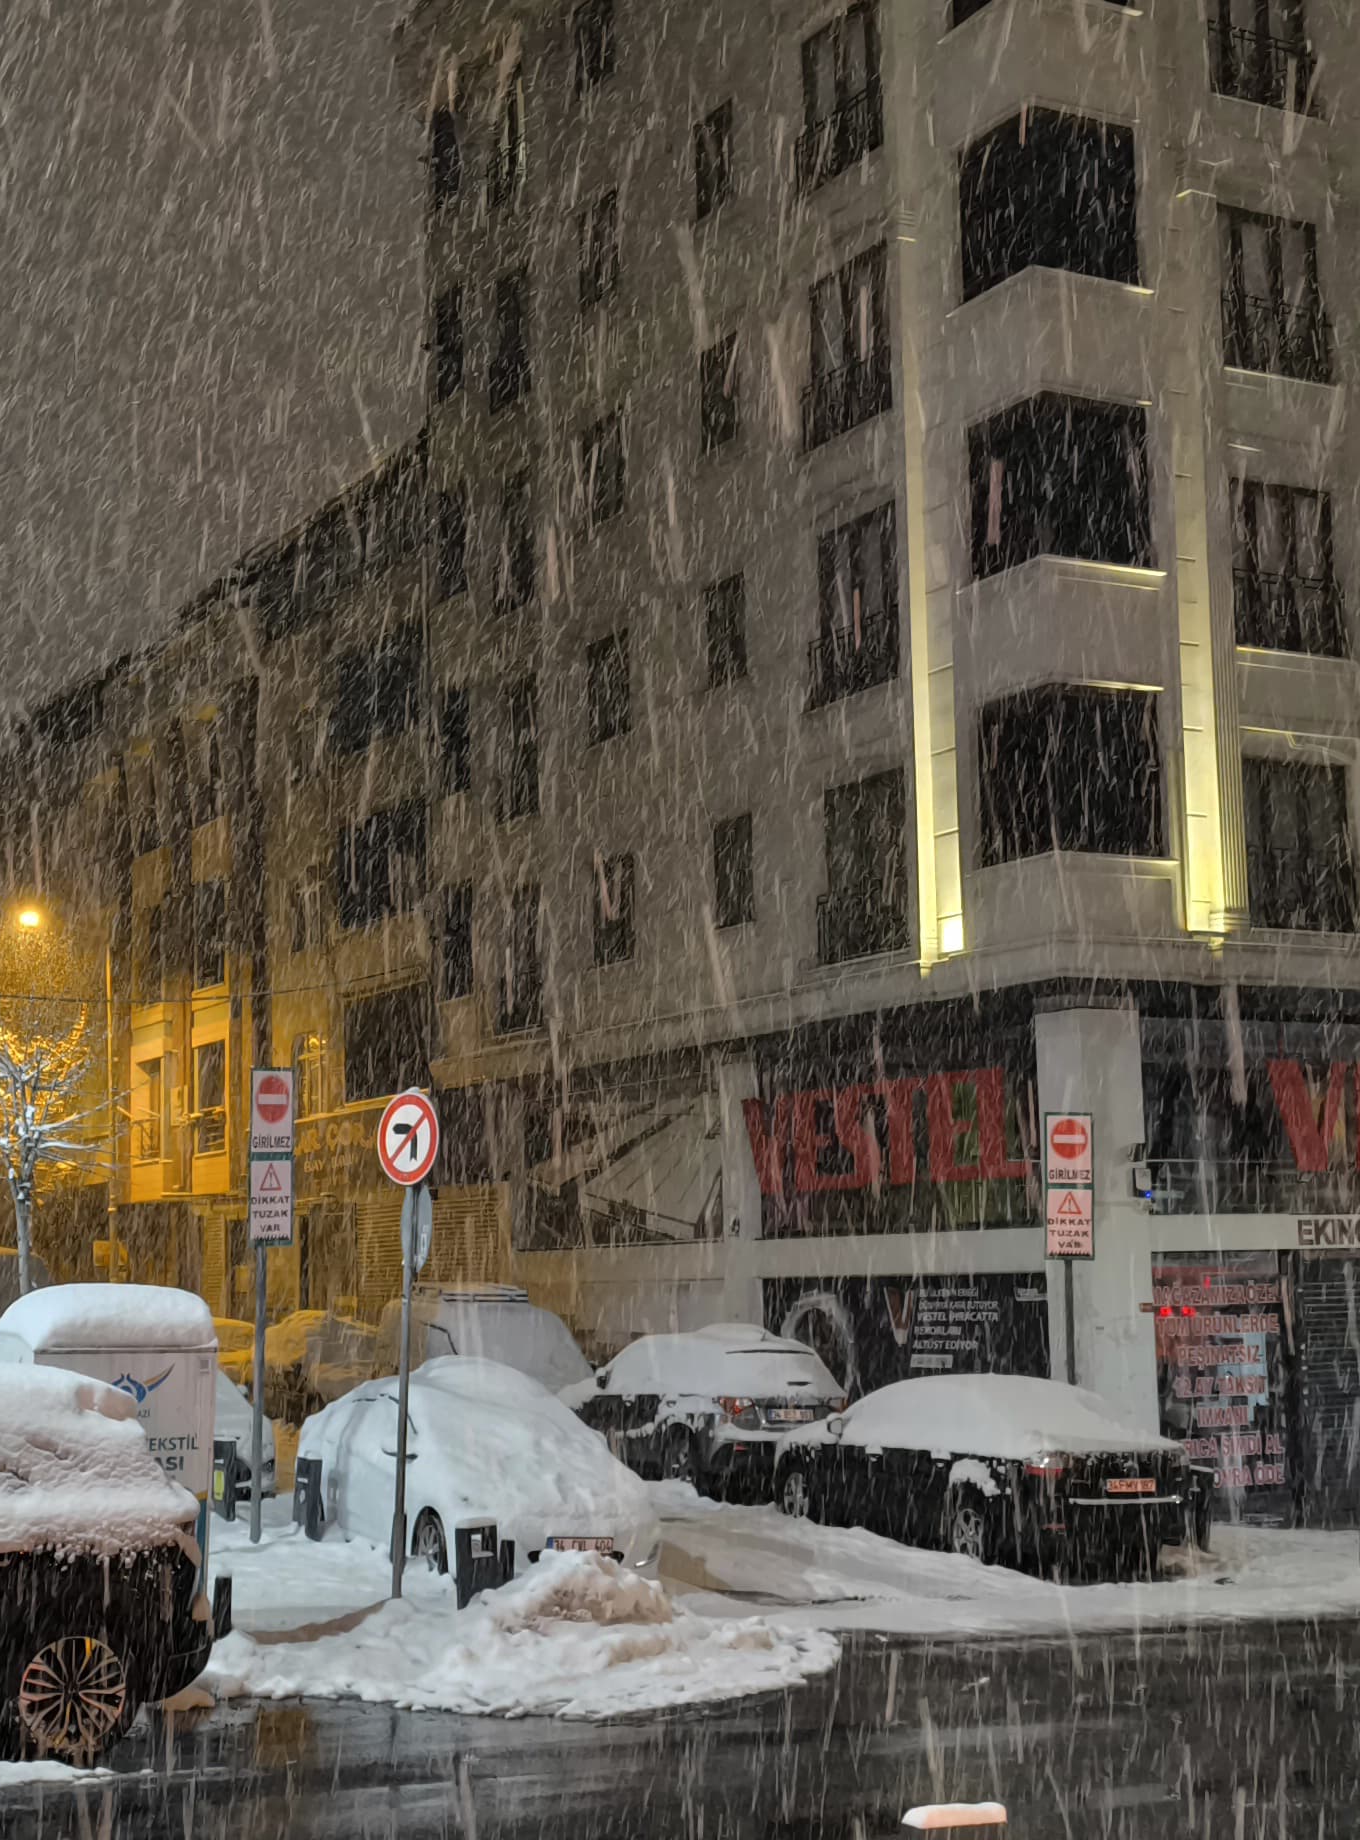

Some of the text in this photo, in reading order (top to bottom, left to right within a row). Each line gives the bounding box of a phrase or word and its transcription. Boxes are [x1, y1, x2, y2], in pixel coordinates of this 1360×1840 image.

[741, 1066, 1033, 1194] VESTEL
[253, 1133, 291, 1149] GİRİLMEZ
[1049, 1167, 1091, 1181] GİRİLMEZ
[251, 1194, 290, 1206] DİKKAT
[252, 1209, 289, 1219] TUZAK
[1048, 1217, 1091, 1226] DİKKAT
[260, 1223, 281, 1233] VAR
[1049, 1229, 1089, 1237] TUZAK
[1213, 1466, 1253, 1488] ONRA
